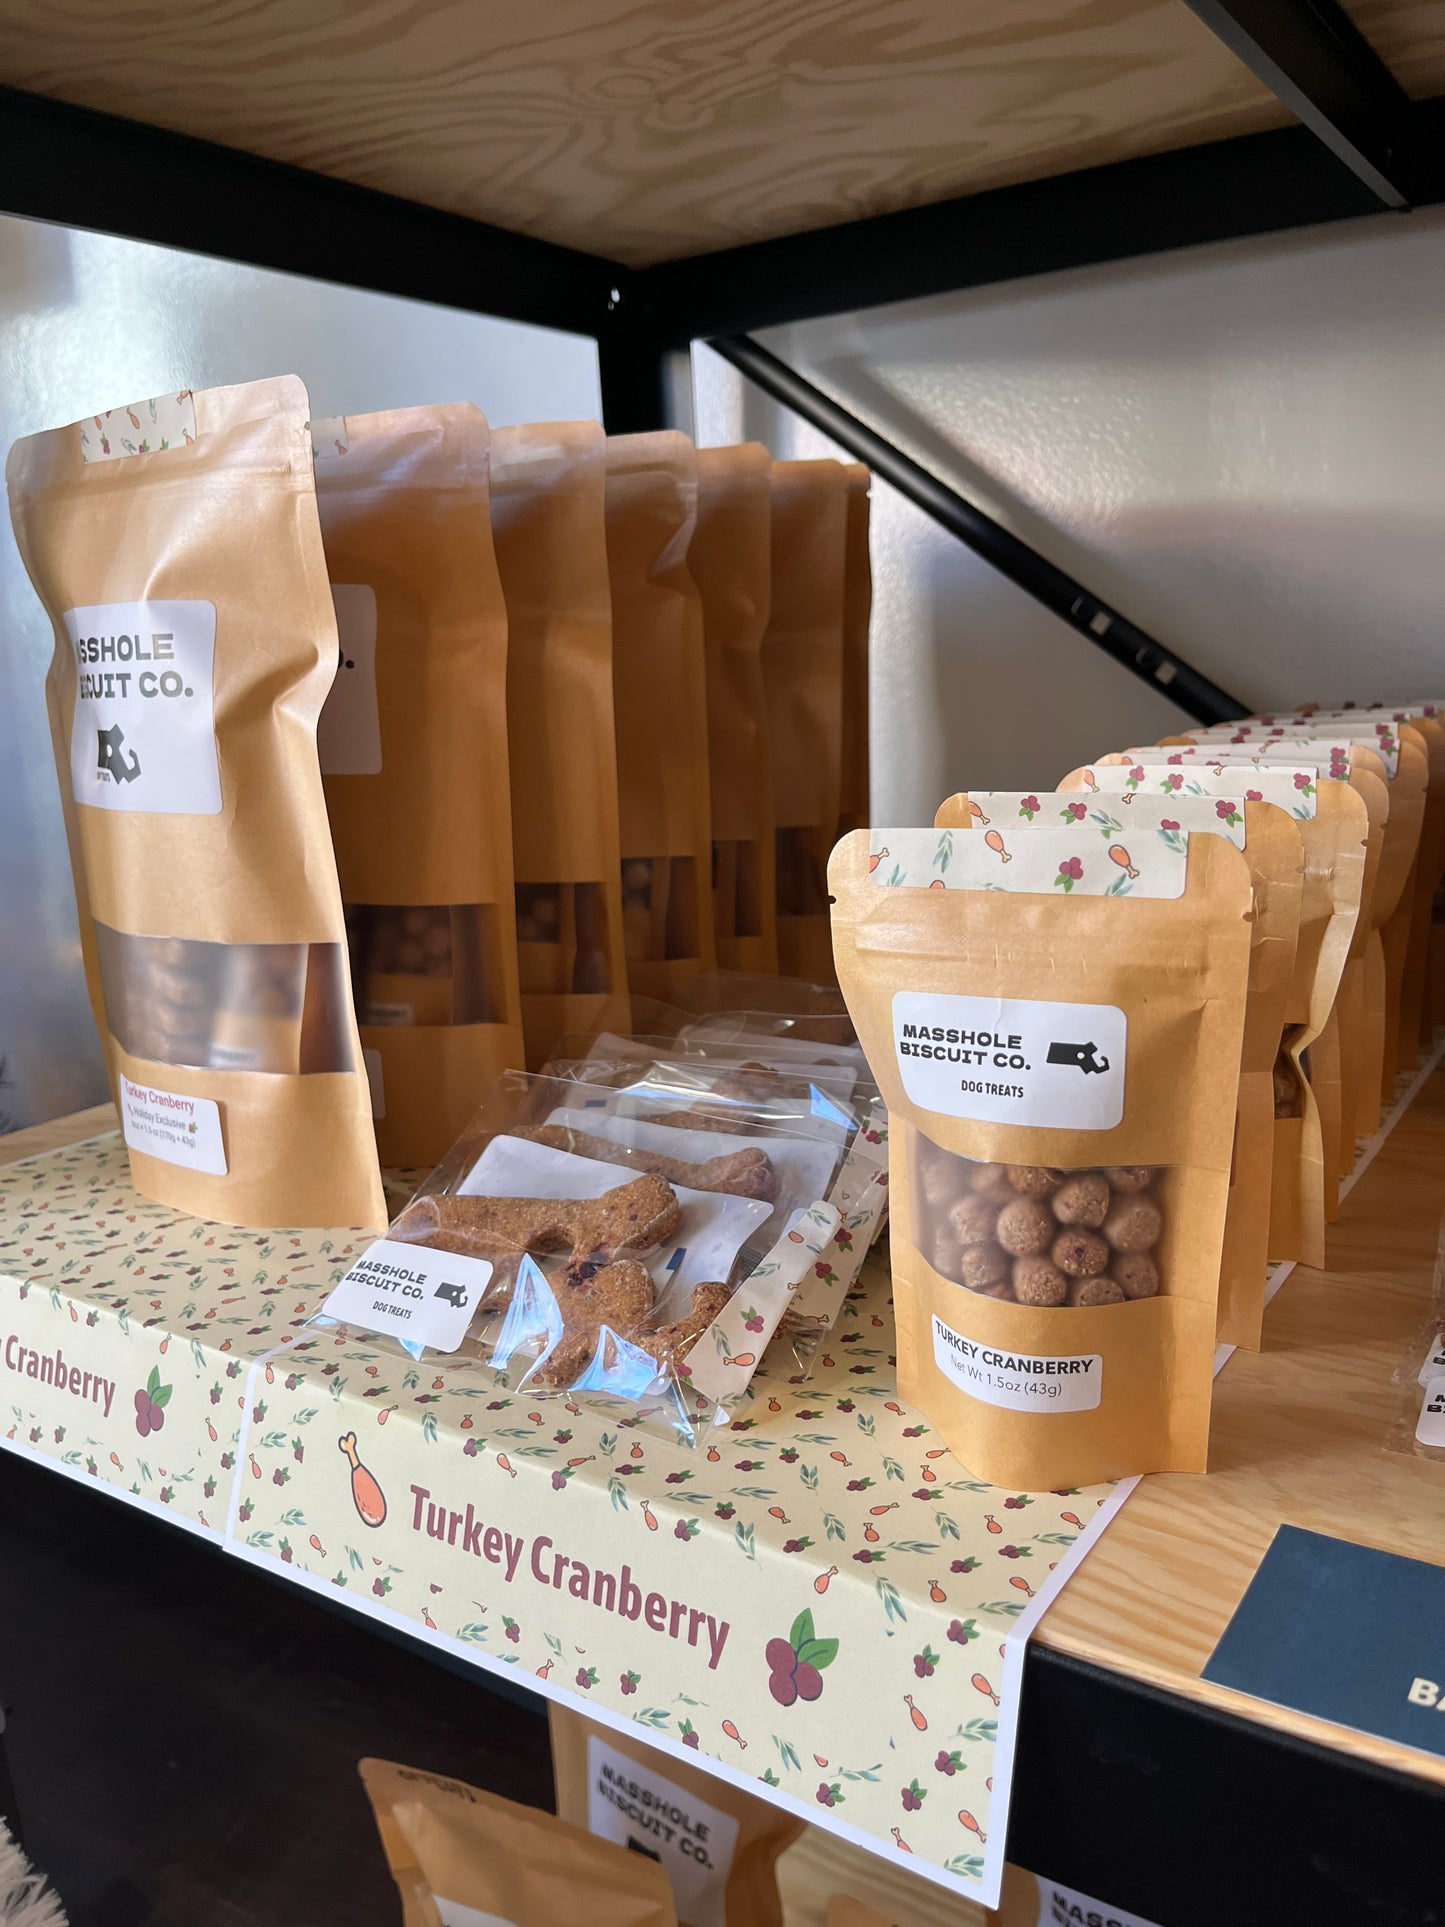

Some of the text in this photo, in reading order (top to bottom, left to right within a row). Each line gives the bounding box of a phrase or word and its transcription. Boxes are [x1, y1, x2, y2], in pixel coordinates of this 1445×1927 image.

[138, 670, 194, 699] CO.
[903, 1024, 1022, 1050] MASSHOLE
[900, 1041, 1032, 1071] BISCUIT CO.
[149, 1090, 195, 1116] Cranberry
[960, 1079, 1024, 1098] DOG TREATS
[345, 1272, 424, 1300] BISCUIT CO.
[356, 1260, 427, 1285] MASSHOLE
[372, 1300, 413, 1320] DOG TREATS
[935, 1320, 1094, 1376] TURKEY CRANBERRY
[5, 1334, 117, 1418] Cranberry
[949, 1353, 1062, 1400] Net Wt 1.5oz (43g)
[409, 1483, 731, 1671] Turkey Cranberry
[602, 1763, 710, 1842] MASSHOLE
[597, 1780, 715, 1871] BISCUIT CO.
